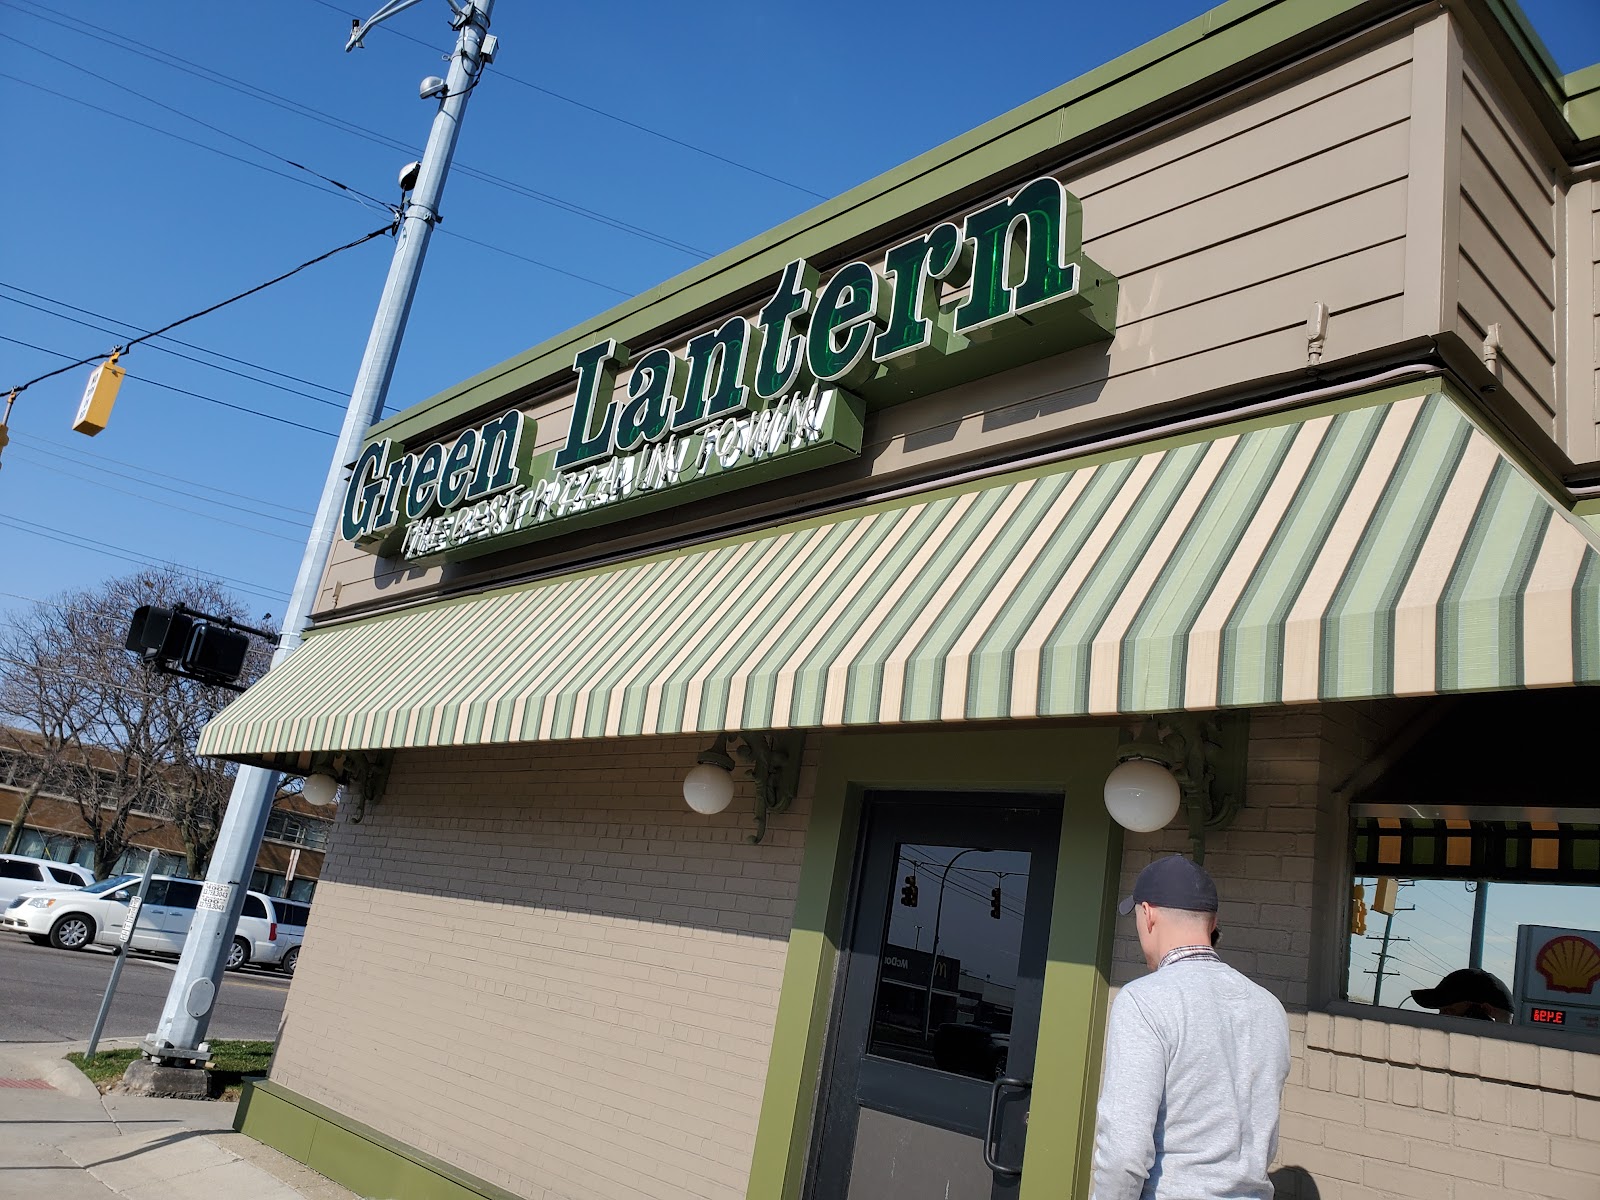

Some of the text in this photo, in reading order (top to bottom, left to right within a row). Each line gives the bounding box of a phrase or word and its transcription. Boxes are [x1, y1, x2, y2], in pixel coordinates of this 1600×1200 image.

[341, 176, 1081, 542] Green Lantern
[400, 383, 834, 559] THE BEST PIZZA IN TOWN
